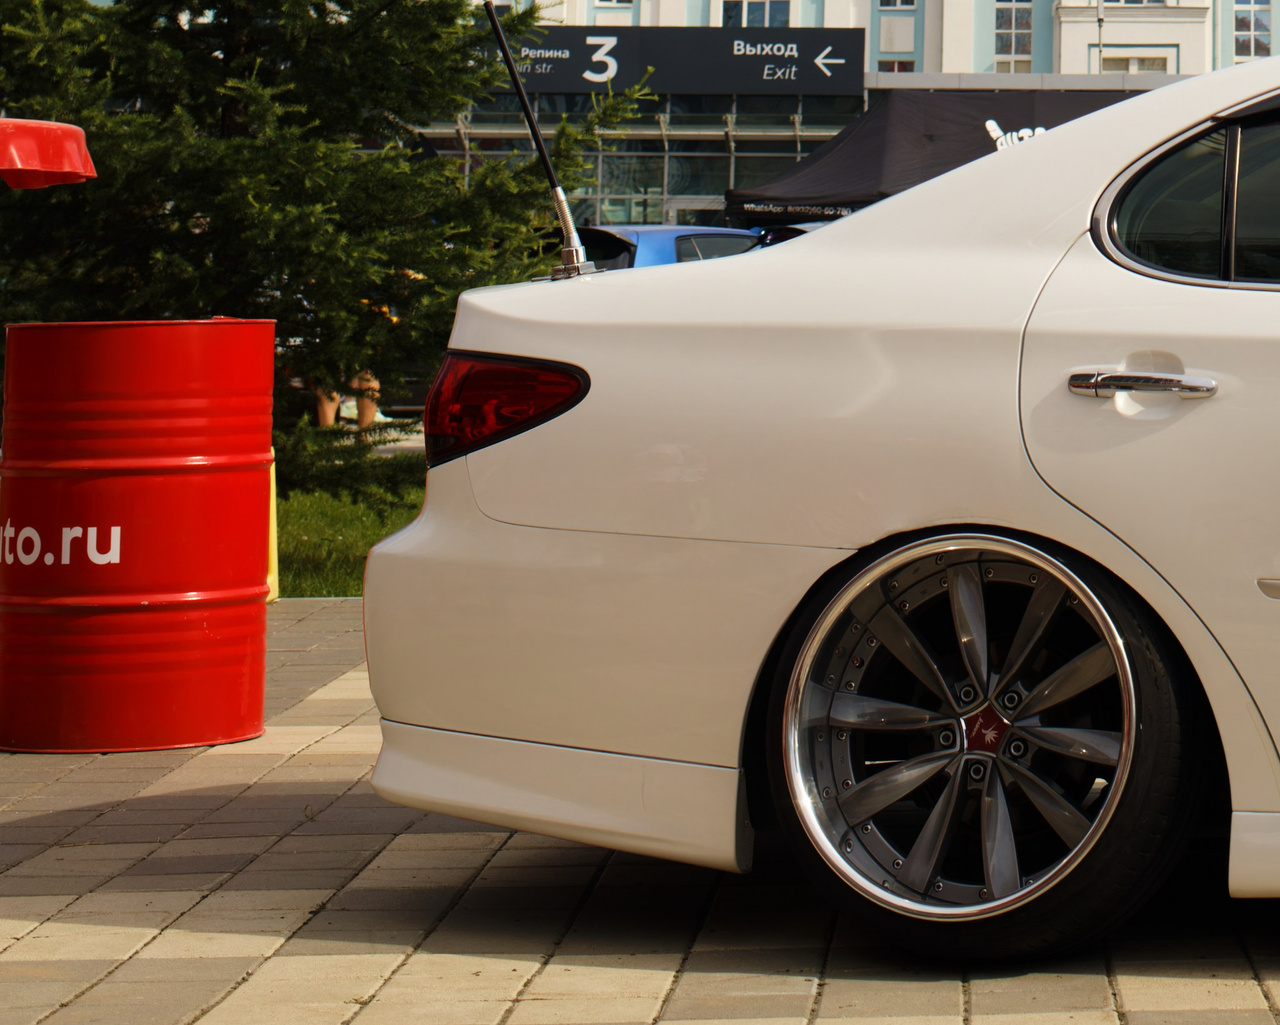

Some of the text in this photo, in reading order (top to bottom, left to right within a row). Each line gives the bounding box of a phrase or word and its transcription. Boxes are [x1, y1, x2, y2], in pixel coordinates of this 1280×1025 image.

[520, 46, 570, 59] Репина
[733, 40, 799, 58] Выход
[582, 35, 619, 83] 3
[534, 61, 555, 74] str.
[762, 64, 799, 80] Exit
